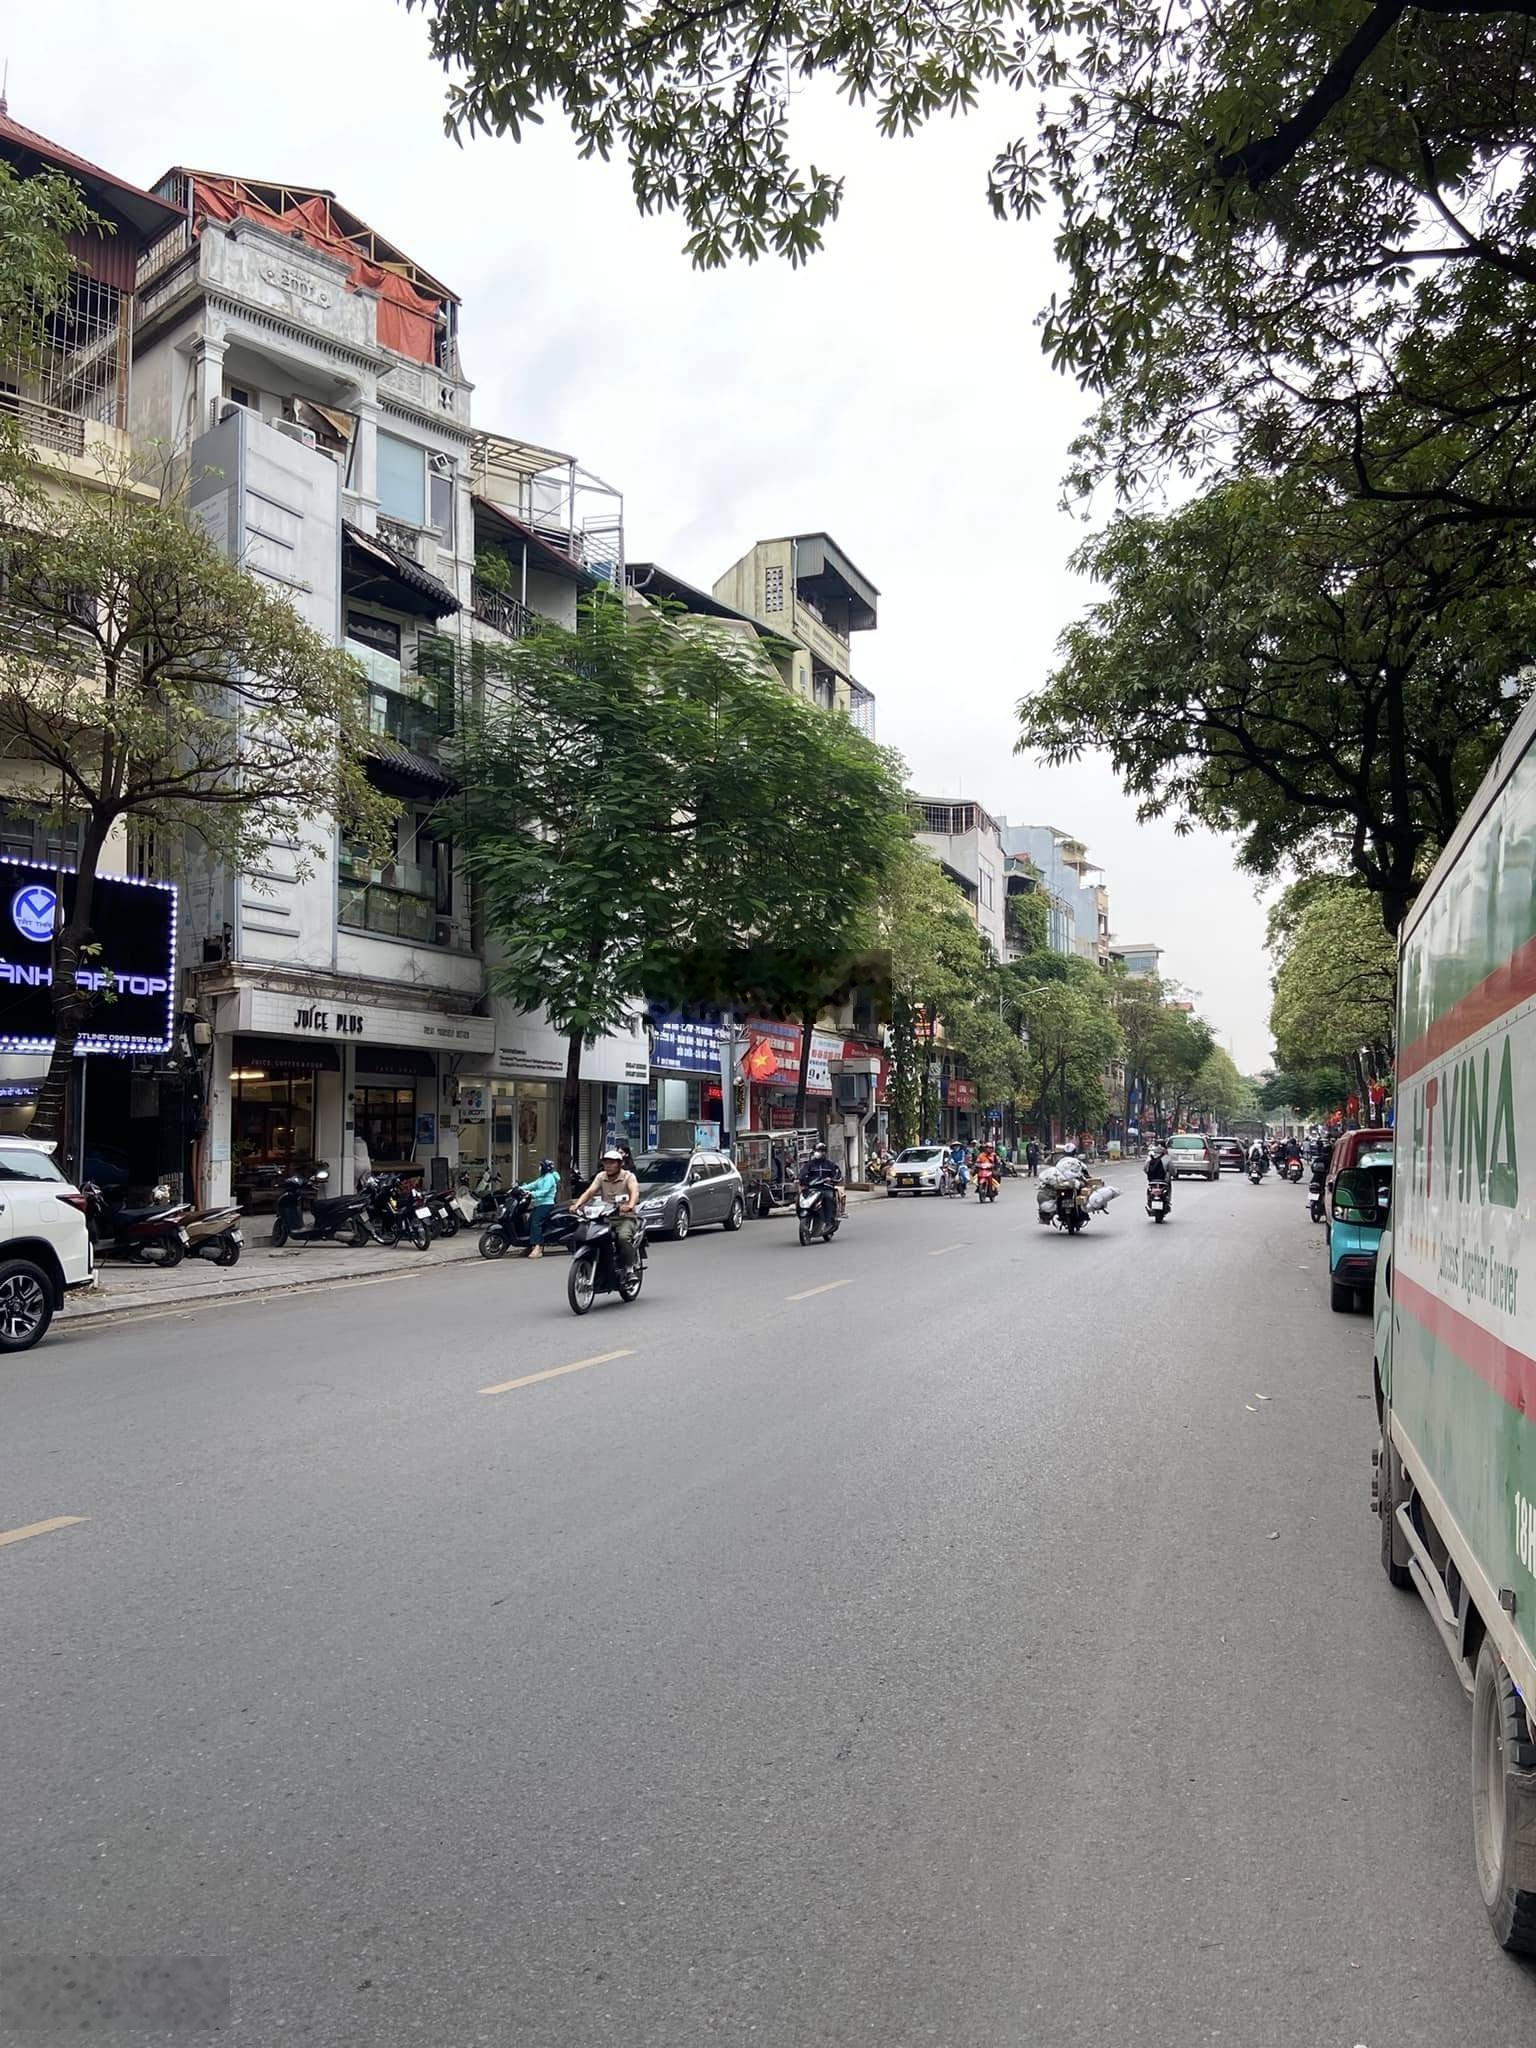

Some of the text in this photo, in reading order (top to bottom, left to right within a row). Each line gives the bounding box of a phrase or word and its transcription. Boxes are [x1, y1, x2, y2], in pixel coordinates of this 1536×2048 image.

[75, 970, 167, 996] APTOP
[336, 1014, 363, 1034] PLUS
[1489, 1245, 1518, 1316] Forever
